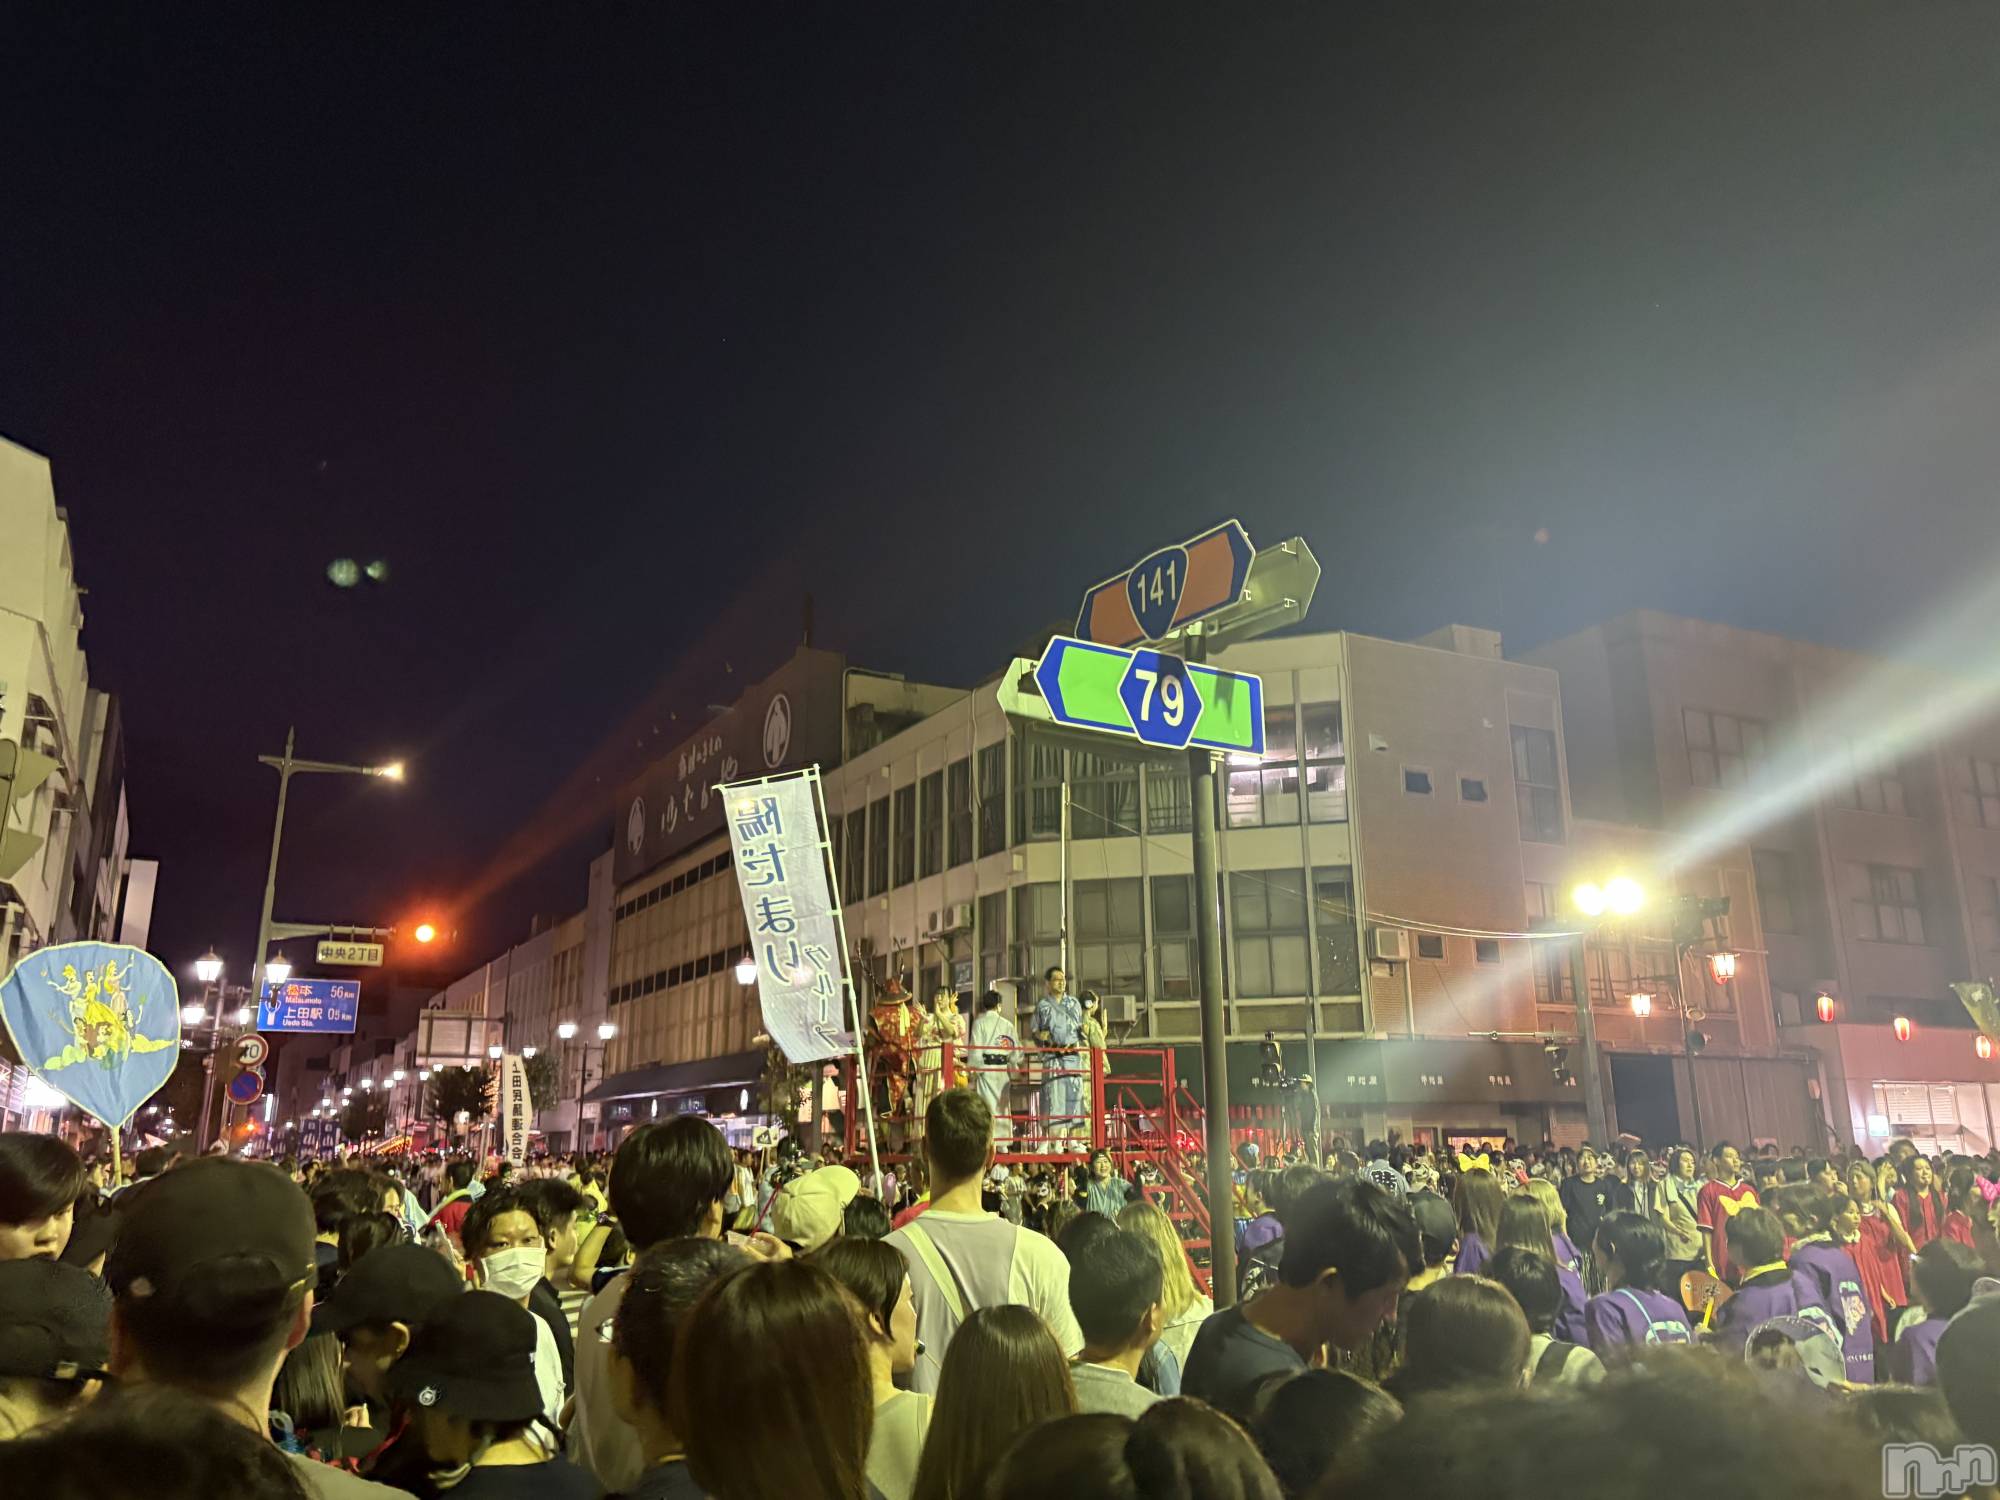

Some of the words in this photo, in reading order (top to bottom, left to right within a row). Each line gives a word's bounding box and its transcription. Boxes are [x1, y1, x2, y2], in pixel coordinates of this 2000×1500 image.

[1137, 560, 1177, 614] 141
[1135, 669, 1185, 726] 79
[321, 946, 378, 961] 中央2丁目
[287, 984, 312, 996] 松本
[331, 986, 344, 999] 56
[284, 1006, 323, 1020] 上田駅
